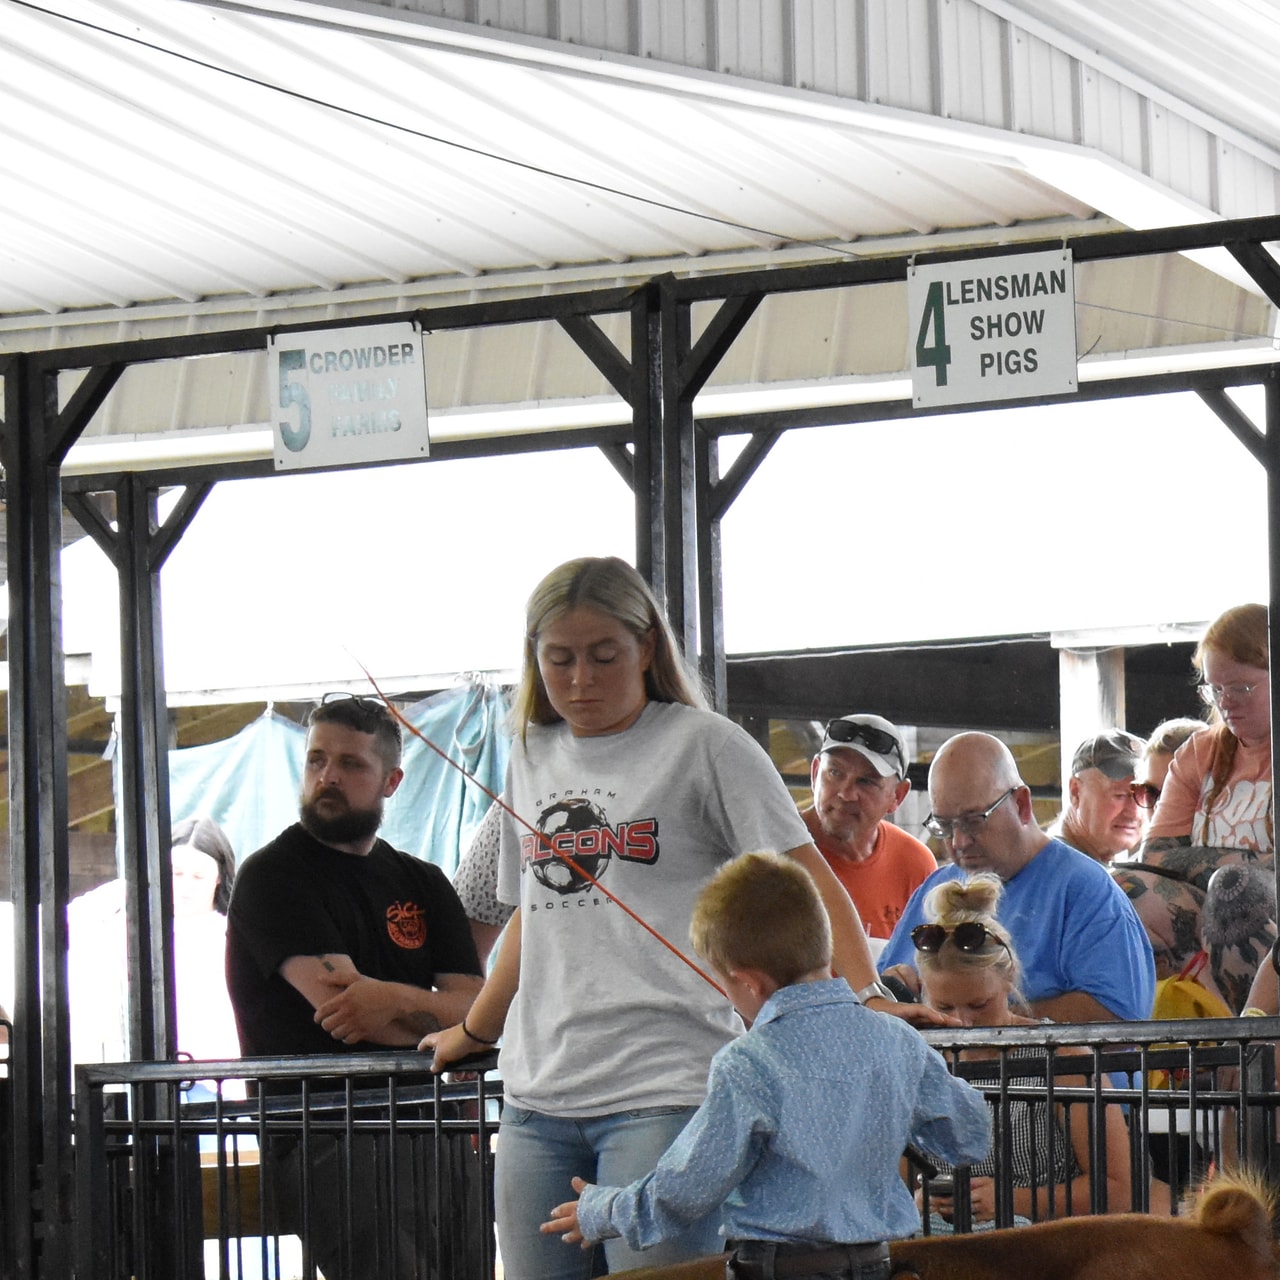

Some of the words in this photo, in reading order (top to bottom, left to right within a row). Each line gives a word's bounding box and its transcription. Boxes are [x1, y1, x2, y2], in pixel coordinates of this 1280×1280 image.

[946, 269, 1066, 306] LENSMAN
[915, 281, 952, 387] 4
[970, 309, 1045, 341] SHOW
[310, 343, 415, 374] CROWDER
[980, 347, 1039, 377] PIGS
[279, 349, 311, 452] 5
[332, 408, 402, 438] FARMS
[535, 788, 617, 807] GRAHAM
[520, 818, 660, 873] ALCONS
